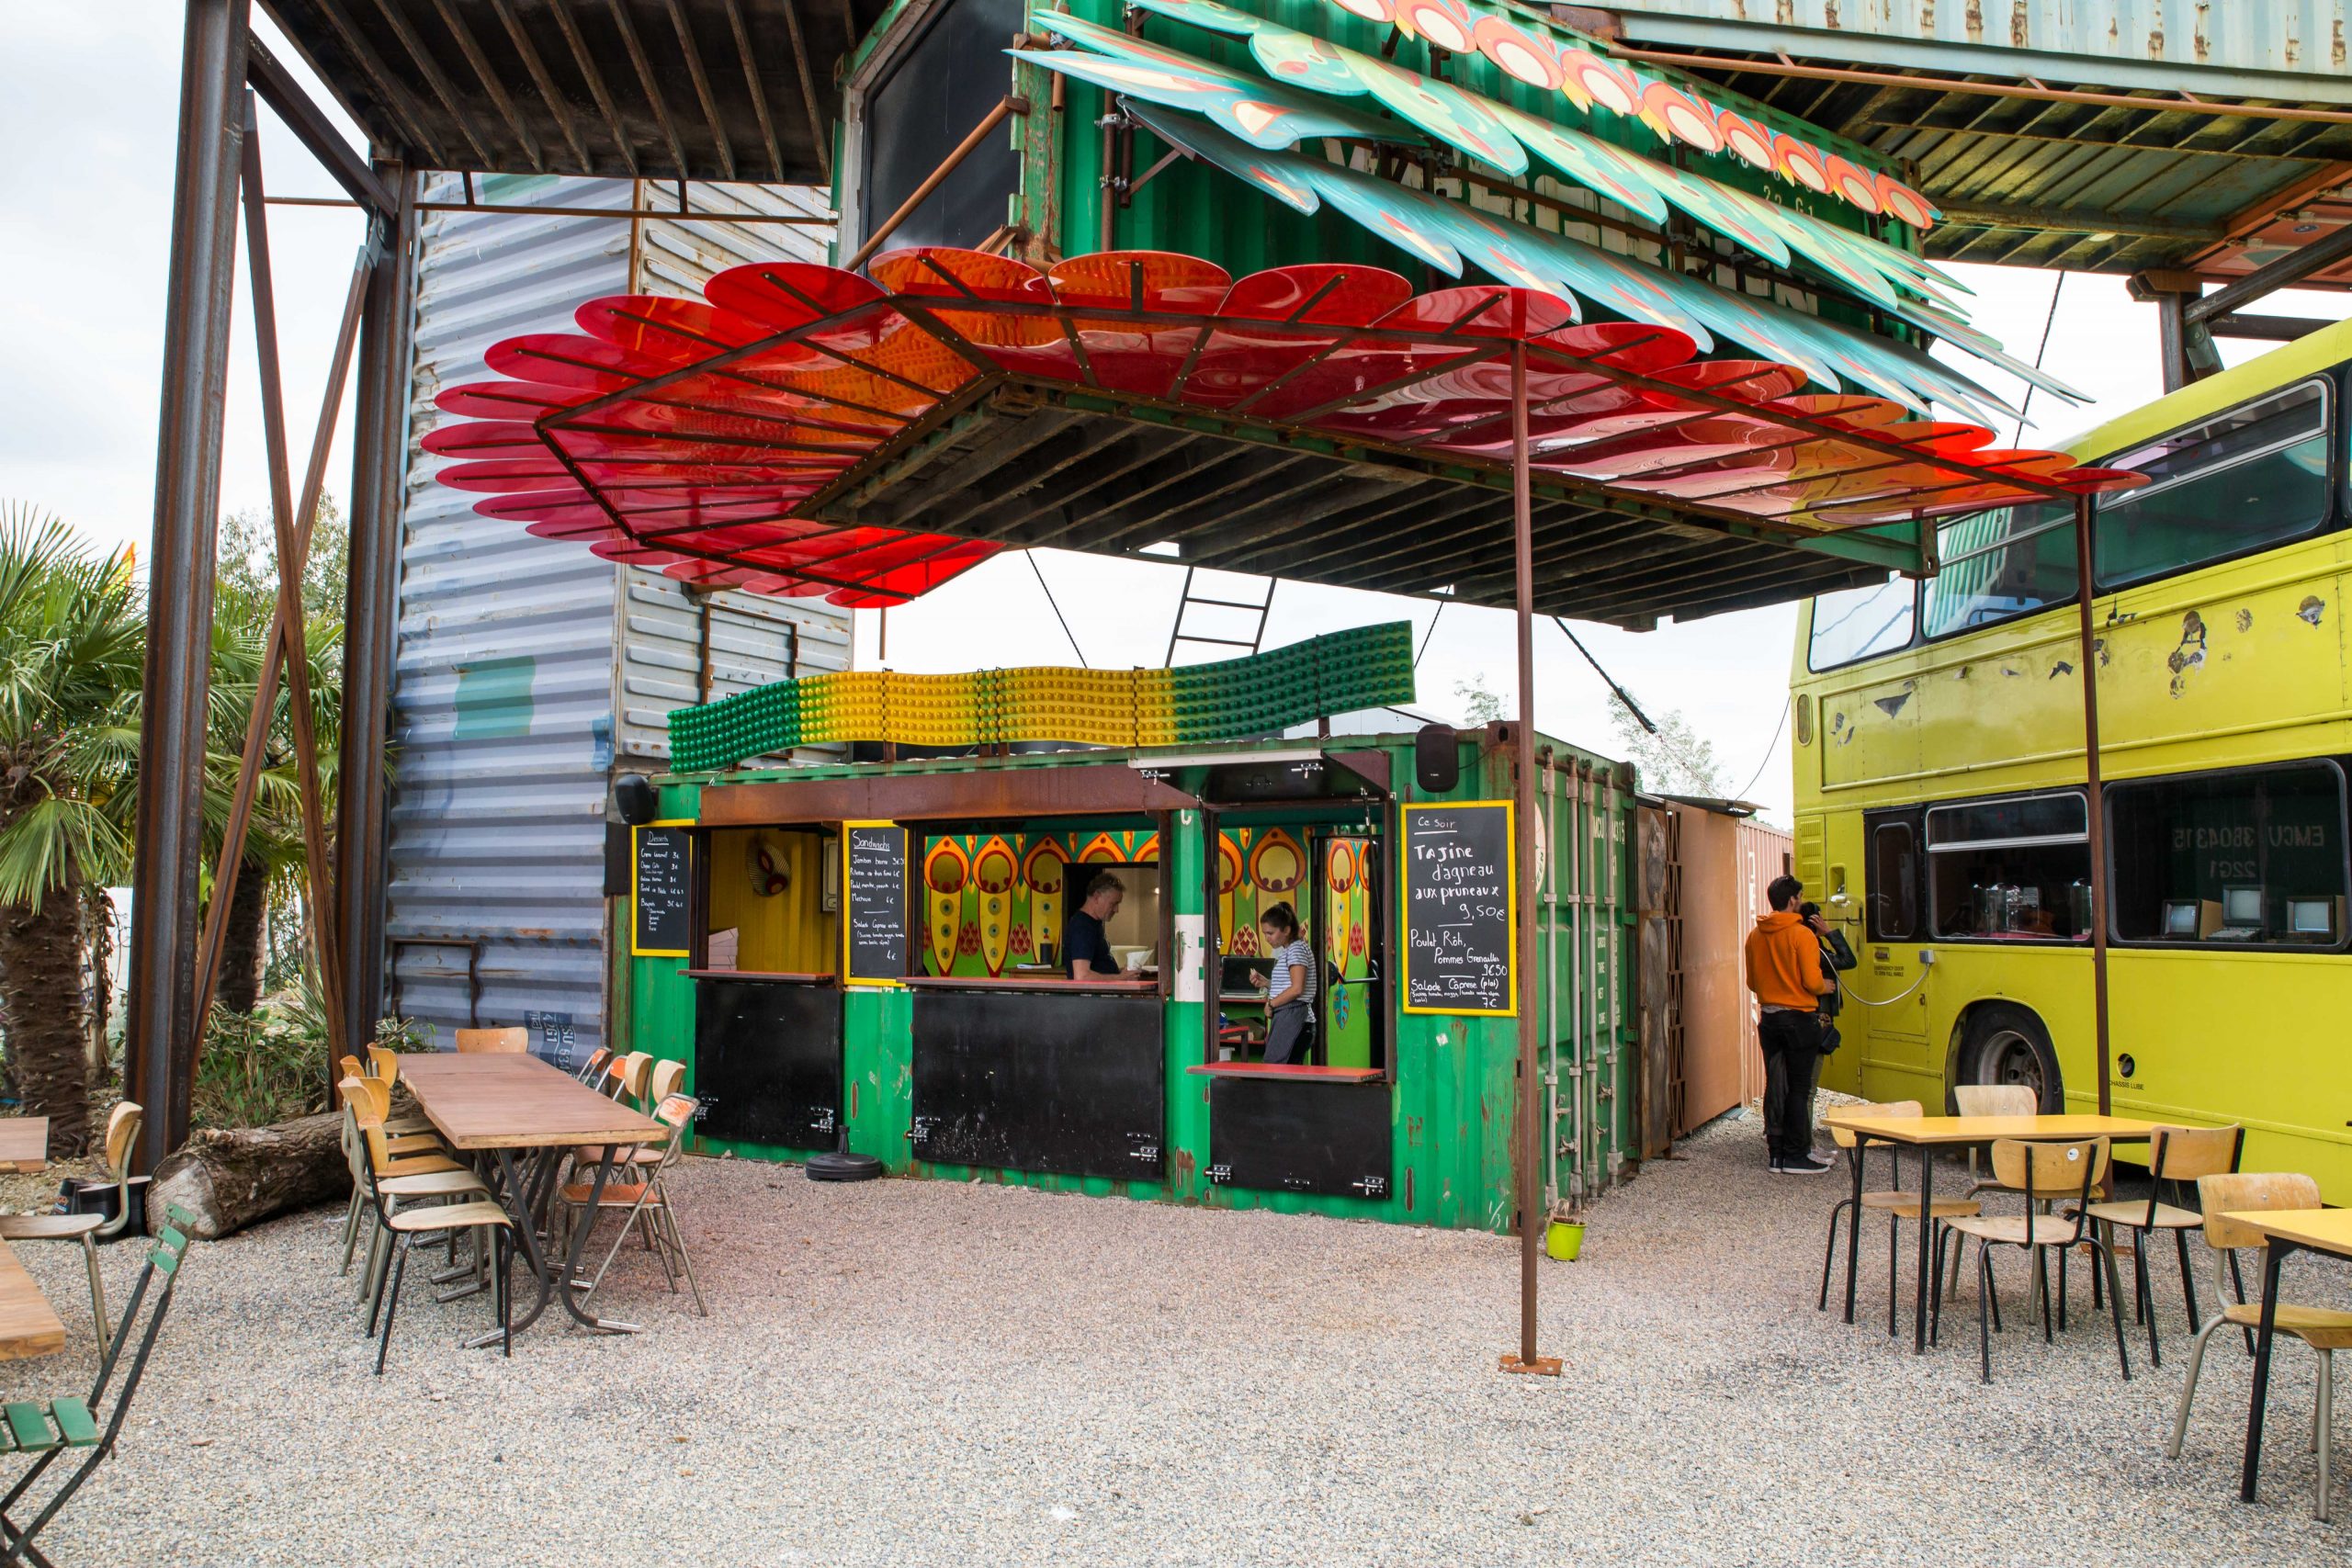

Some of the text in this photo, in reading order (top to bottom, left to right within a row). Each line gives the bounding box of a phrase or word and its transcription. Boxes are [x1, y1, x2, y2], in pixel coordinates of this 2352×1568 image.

[1418, 816, 1430, 827] Ce
[1592, 816, 1605, 838] MCU
[852, 829, 890, 849] Sandwichs
[853, 854, 872, 865] Jambon
[1432, 863, 1494, 885] d'agneau
[1415, 886, 1499, 906] aux pruneaux
[1410, 929, 1437, 947] Poulet
[1434, 947, 1499, 964] Pommes Grenailles
[1411, 978, 1442, 992] Salade
[1482, 998, 1498, 1009] 7€
